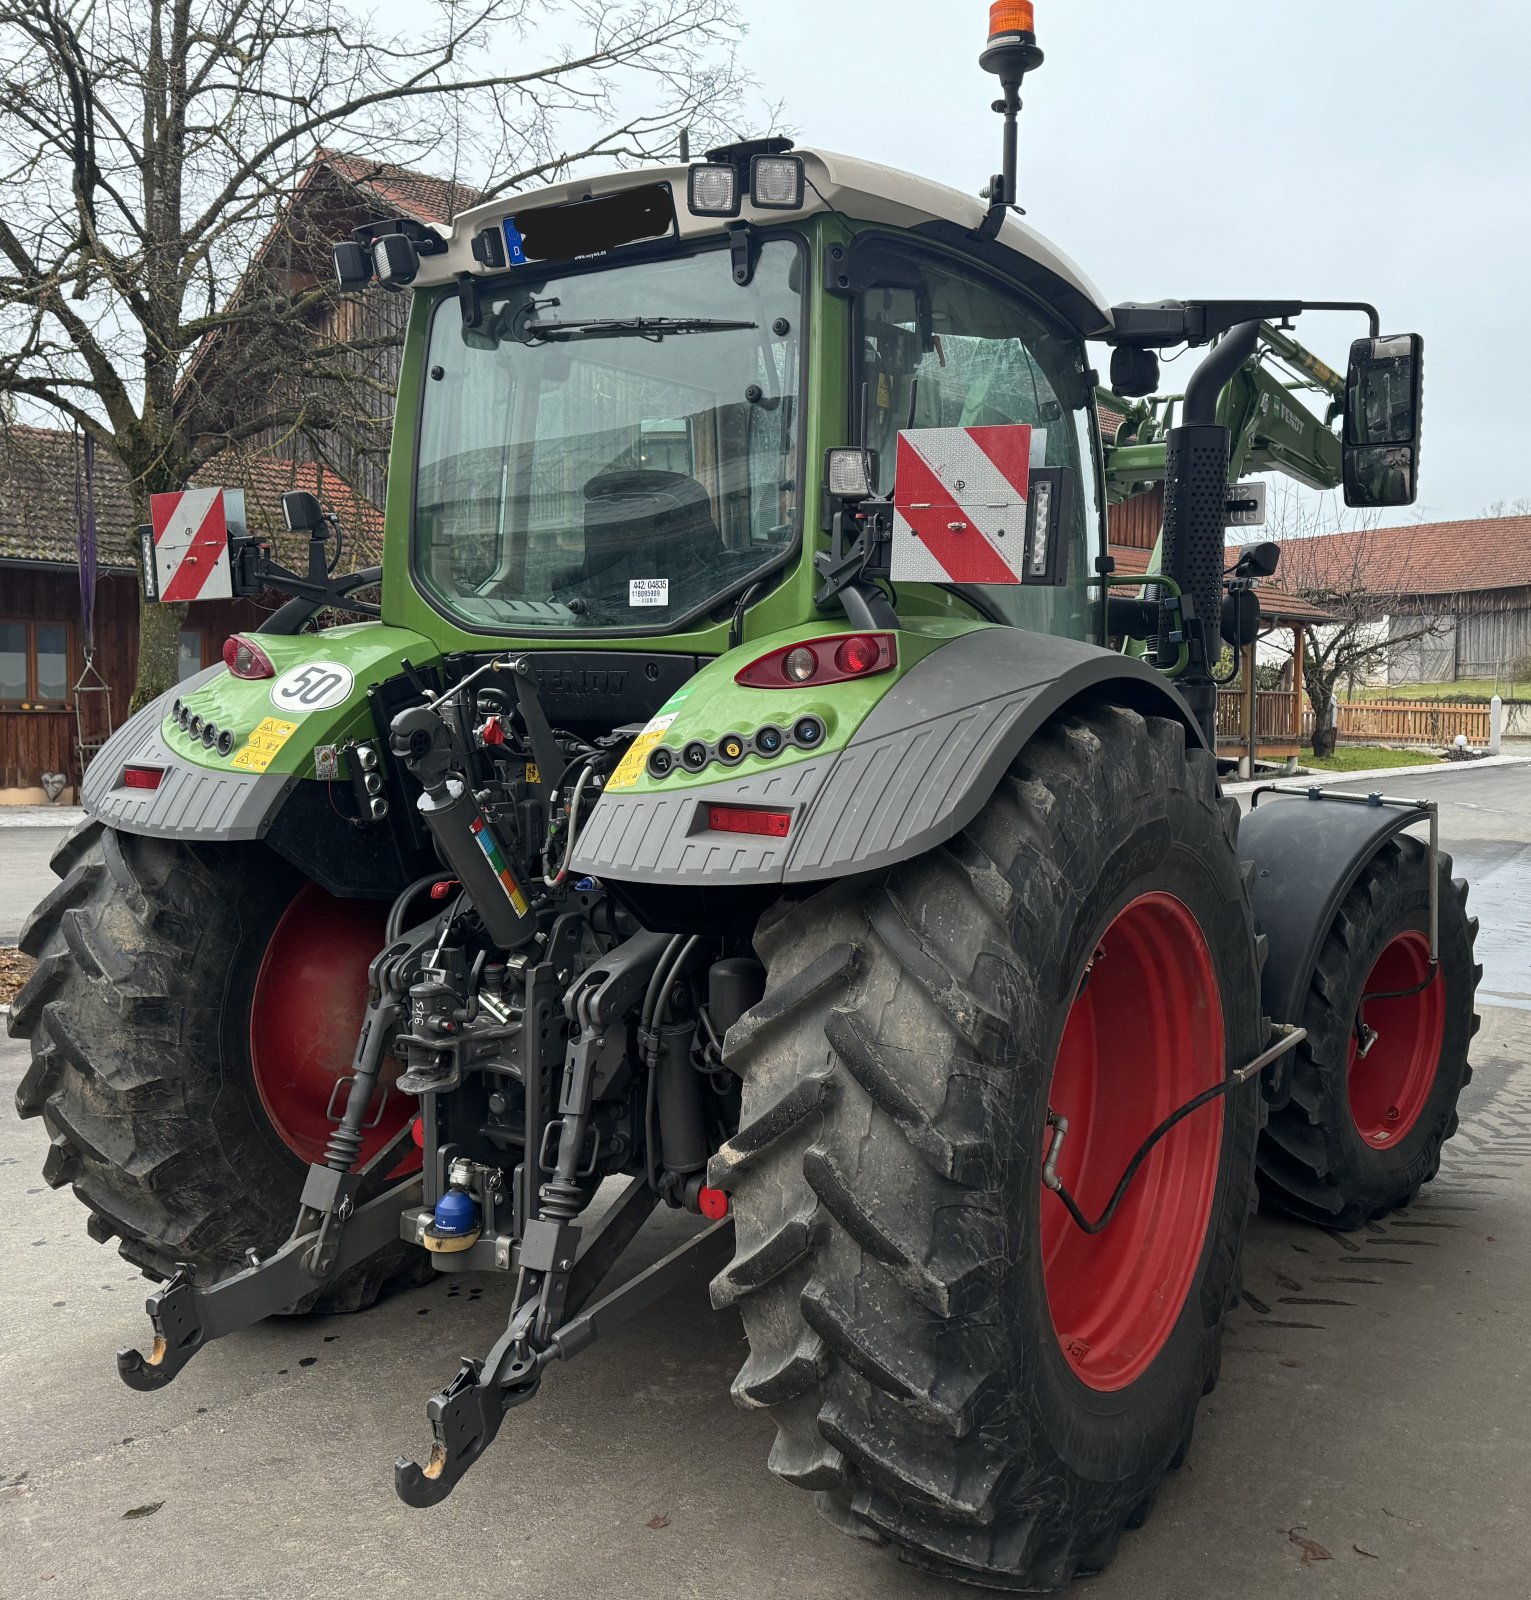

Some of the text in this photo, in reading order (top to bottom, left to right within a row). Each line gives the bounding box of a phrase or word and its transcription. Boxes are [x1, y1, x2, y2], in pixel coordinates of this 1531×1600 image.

[513, 246, 520, 256] D
[1281, 402, 1305, 435] FENDT
[281, 666, 343, 704] 50
